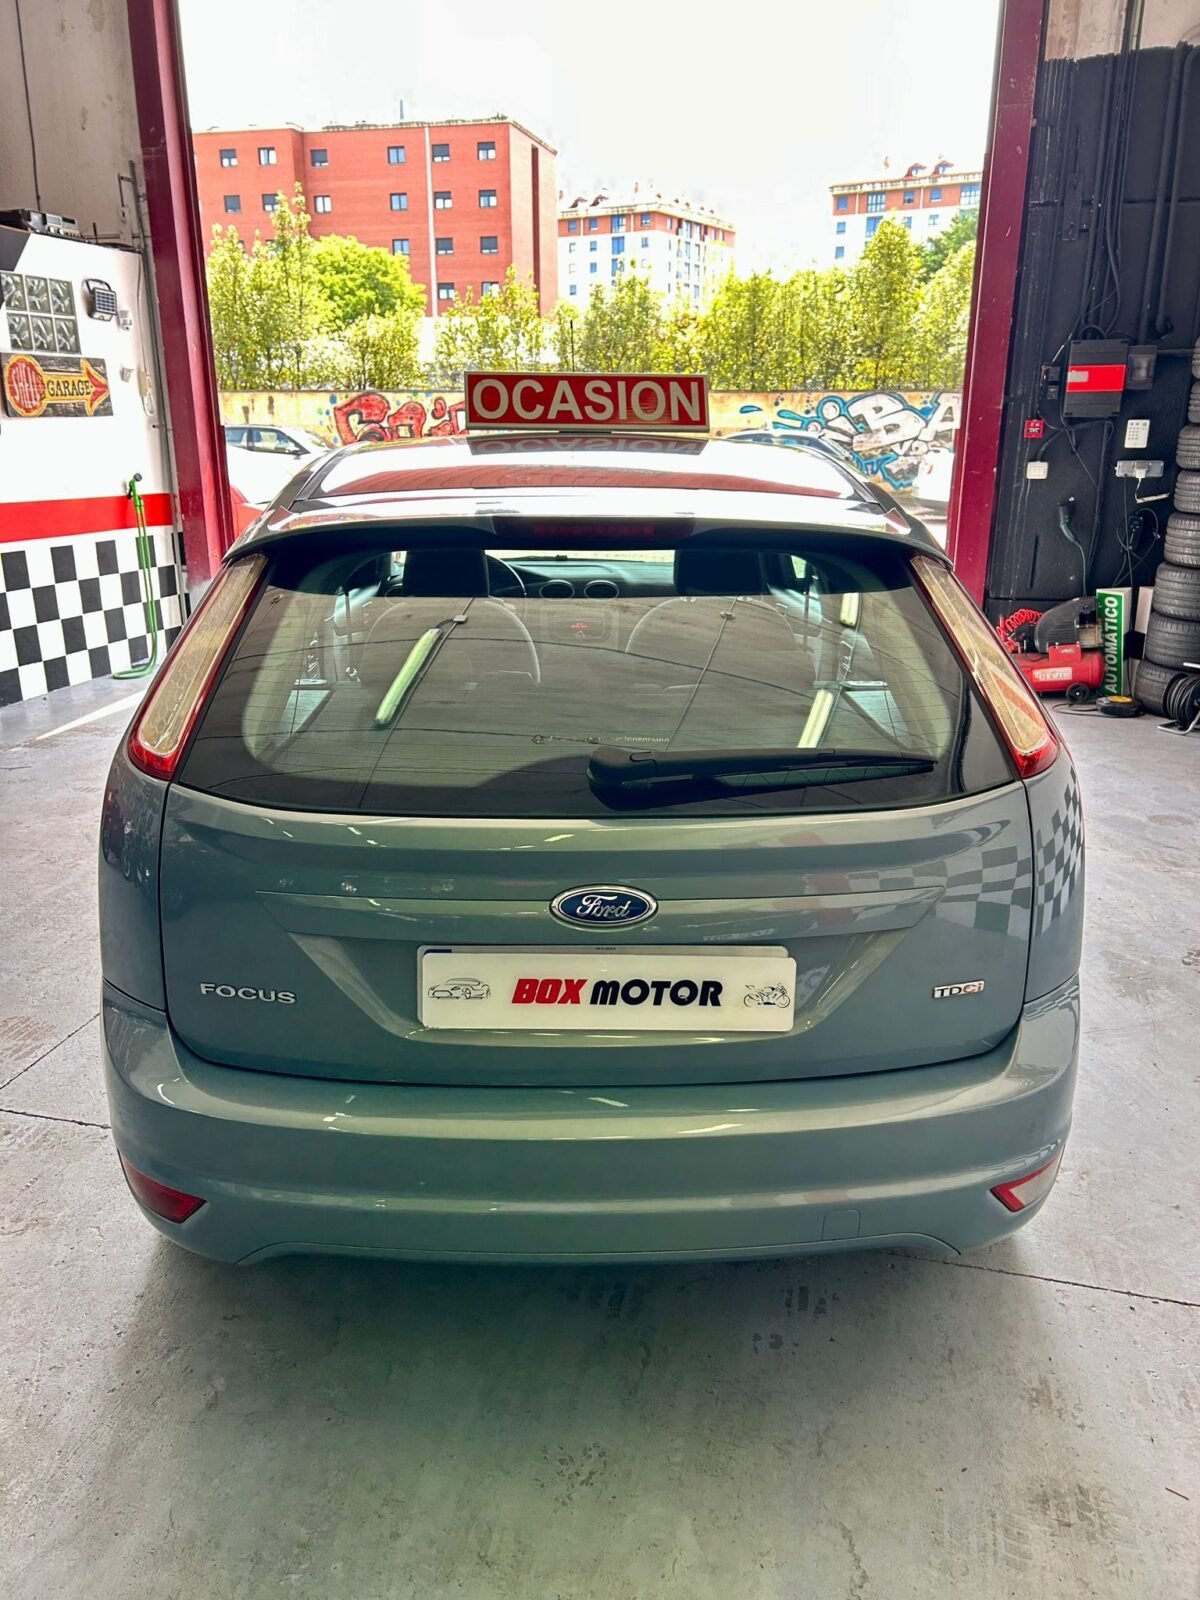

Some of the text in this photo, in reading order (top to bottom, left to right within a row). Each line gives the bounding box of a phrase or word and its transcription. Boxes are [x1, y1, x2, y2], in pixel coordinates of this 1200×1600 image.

[47, 379, 92, 397] GARAGE
[472, 378, 701, 422] OCASION
[1104, 596, 1119, 694] AUTOMATICO
[576, 894, 631, 918] Ford
[200, 983, 296, 1004] FOCUS
[511, 978, 723, 1007] BOX MOTOR
[936, 982, 983, 997] TDCi
